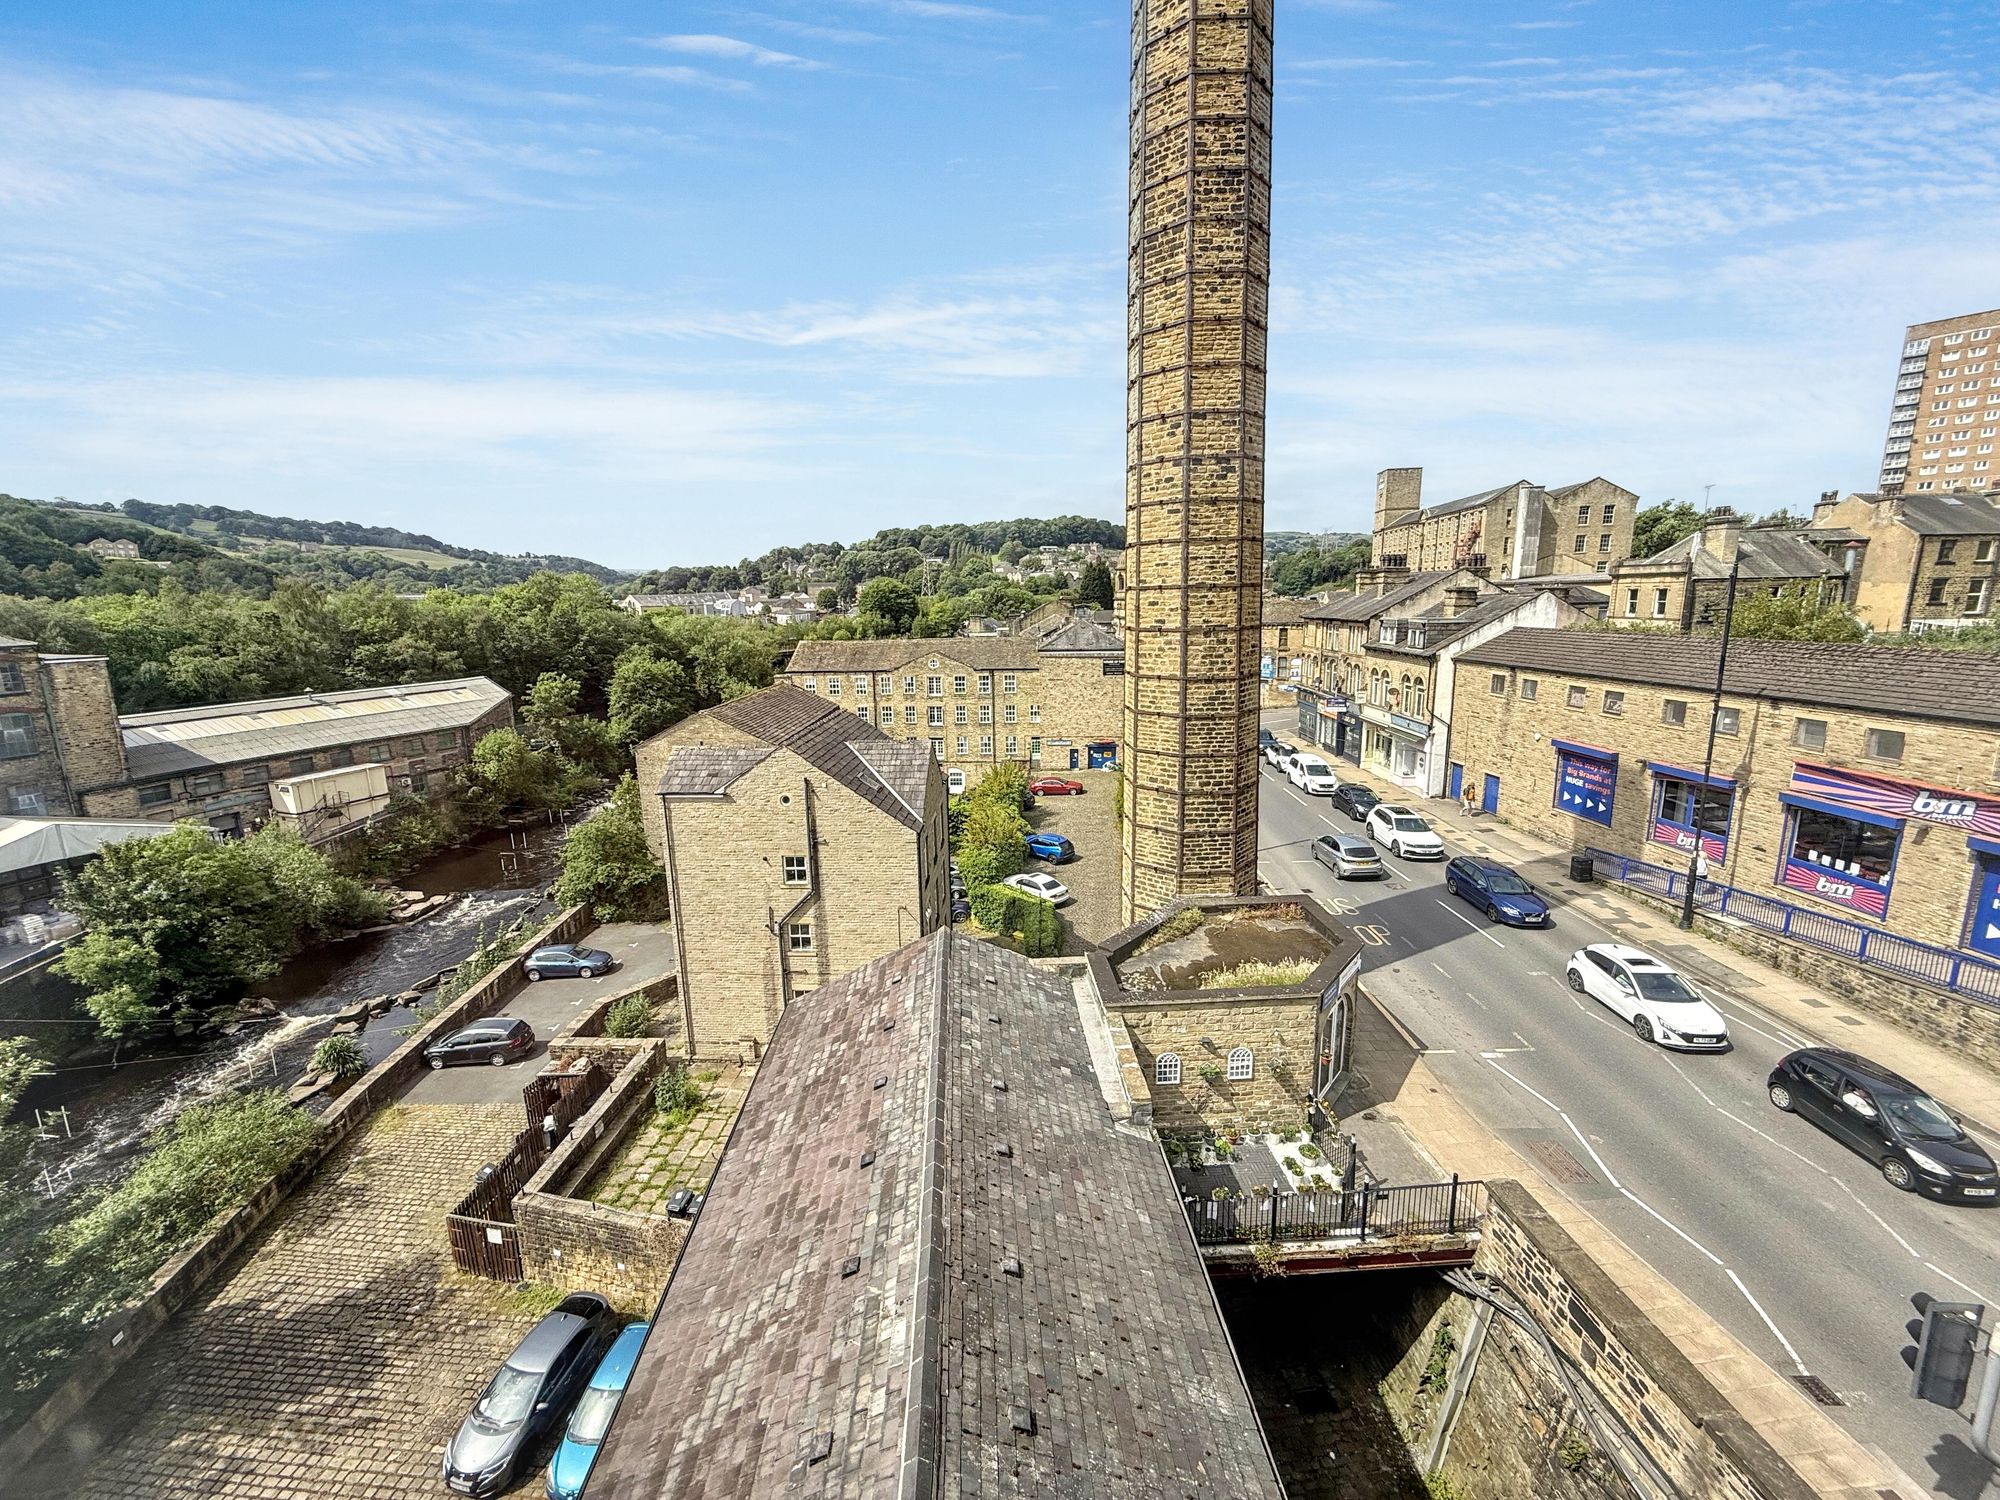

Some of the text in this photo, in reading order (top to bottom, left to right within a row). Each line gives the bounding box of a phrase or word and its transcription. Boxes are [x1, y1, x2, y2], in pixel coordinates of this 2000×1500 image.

[1567, 766, 1578, 776] Big
[1579, 770, 1602, 782] Brands
[1570, 757, 1612, 774] This way for
[1566, 776, 1611, 795] HUGE savings
